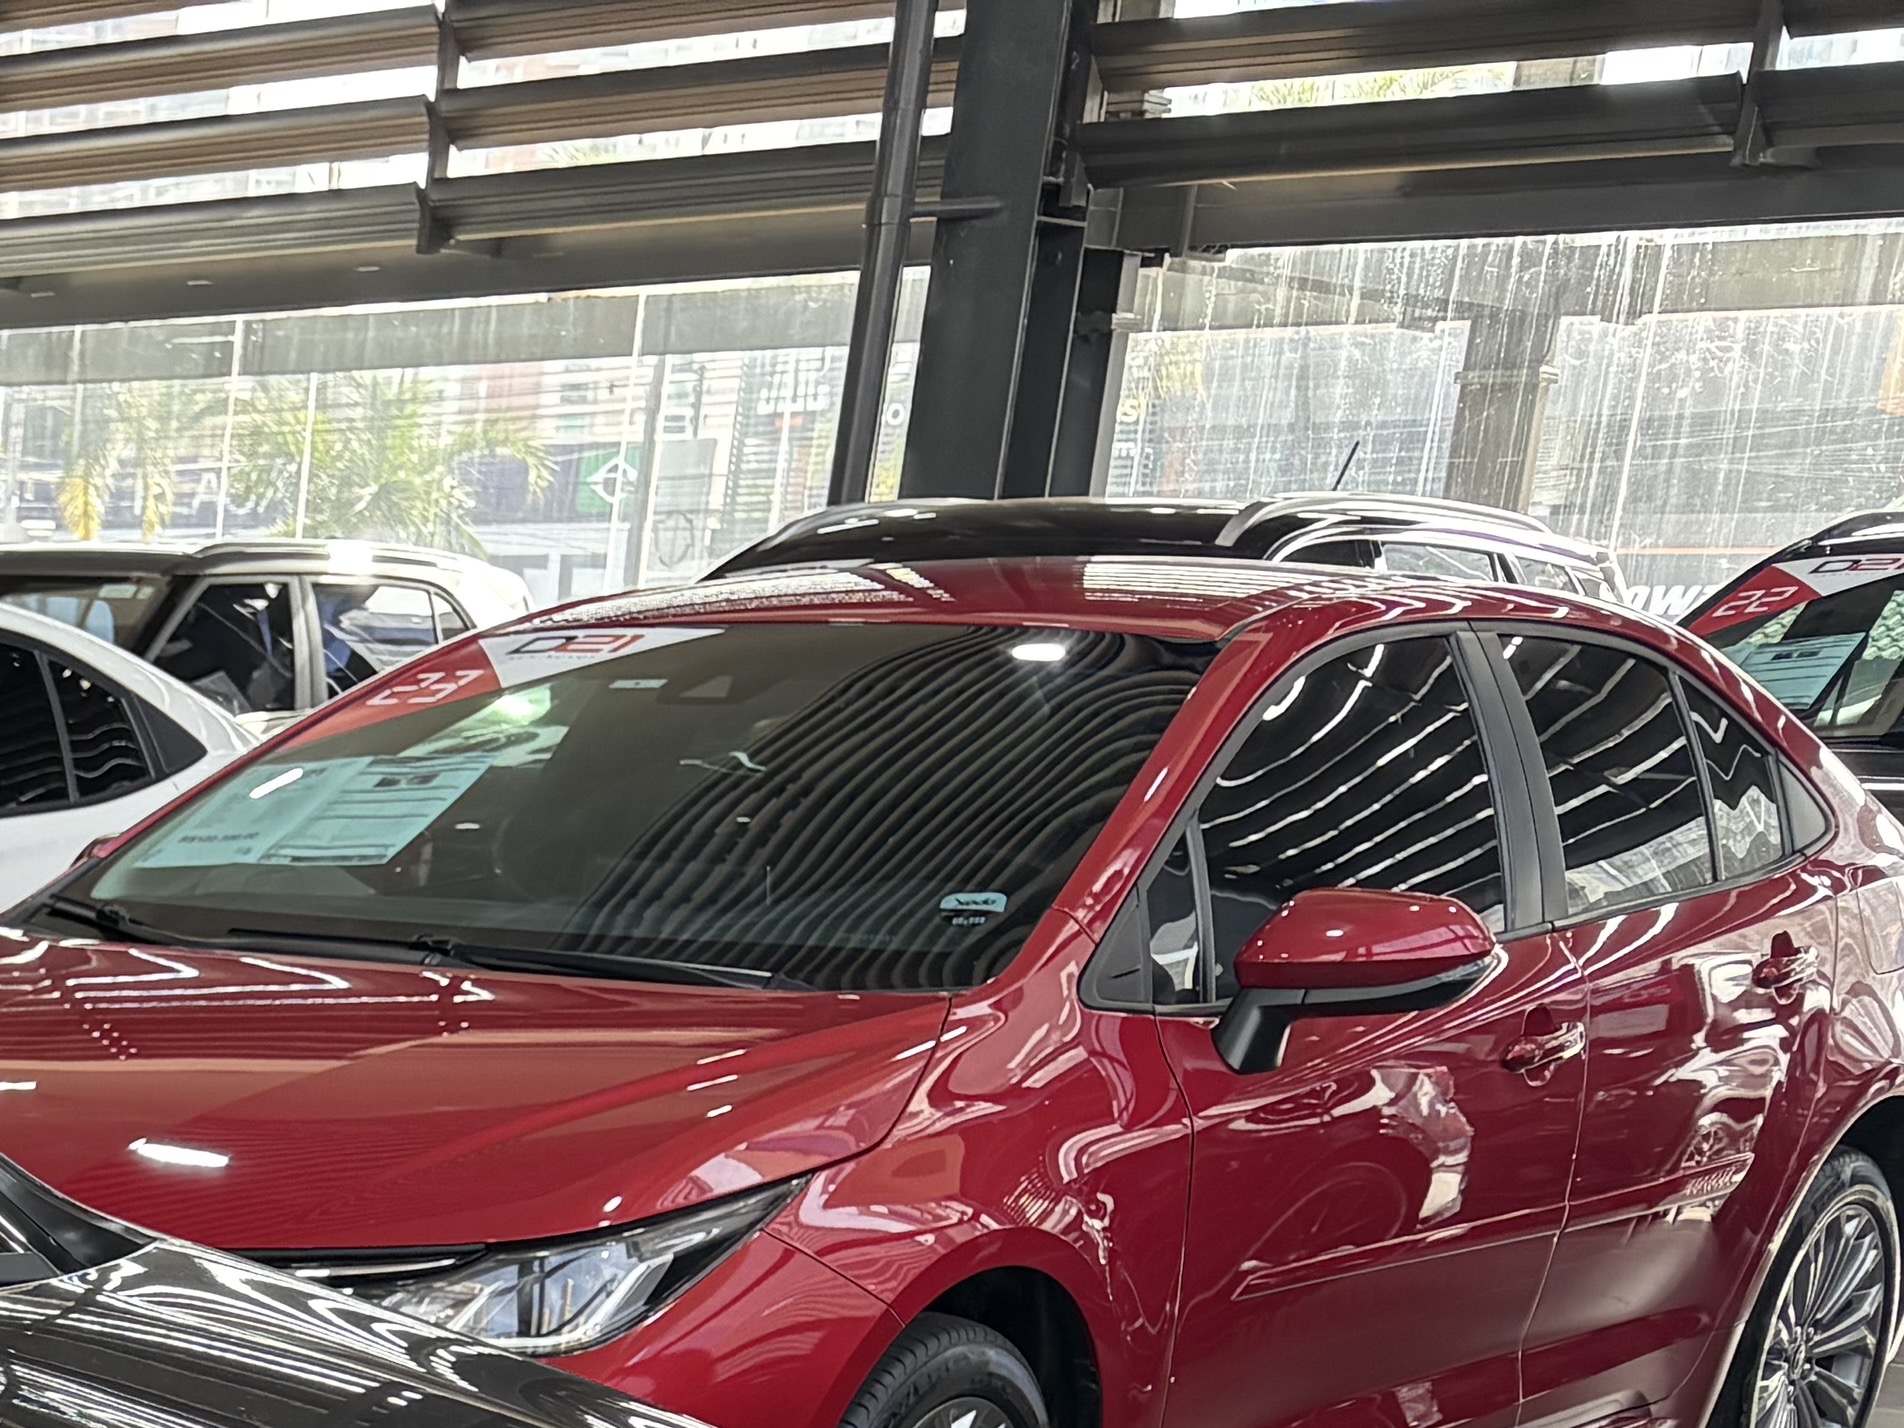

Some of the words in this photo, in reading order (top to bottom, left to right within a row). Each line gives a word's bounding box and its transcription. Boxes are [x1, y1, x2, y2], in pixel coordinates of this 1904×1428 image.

[1711, 586, 1799, 617] 22
[505, 634, 645, 655] D21
[365, 669, 485, 706] 23
